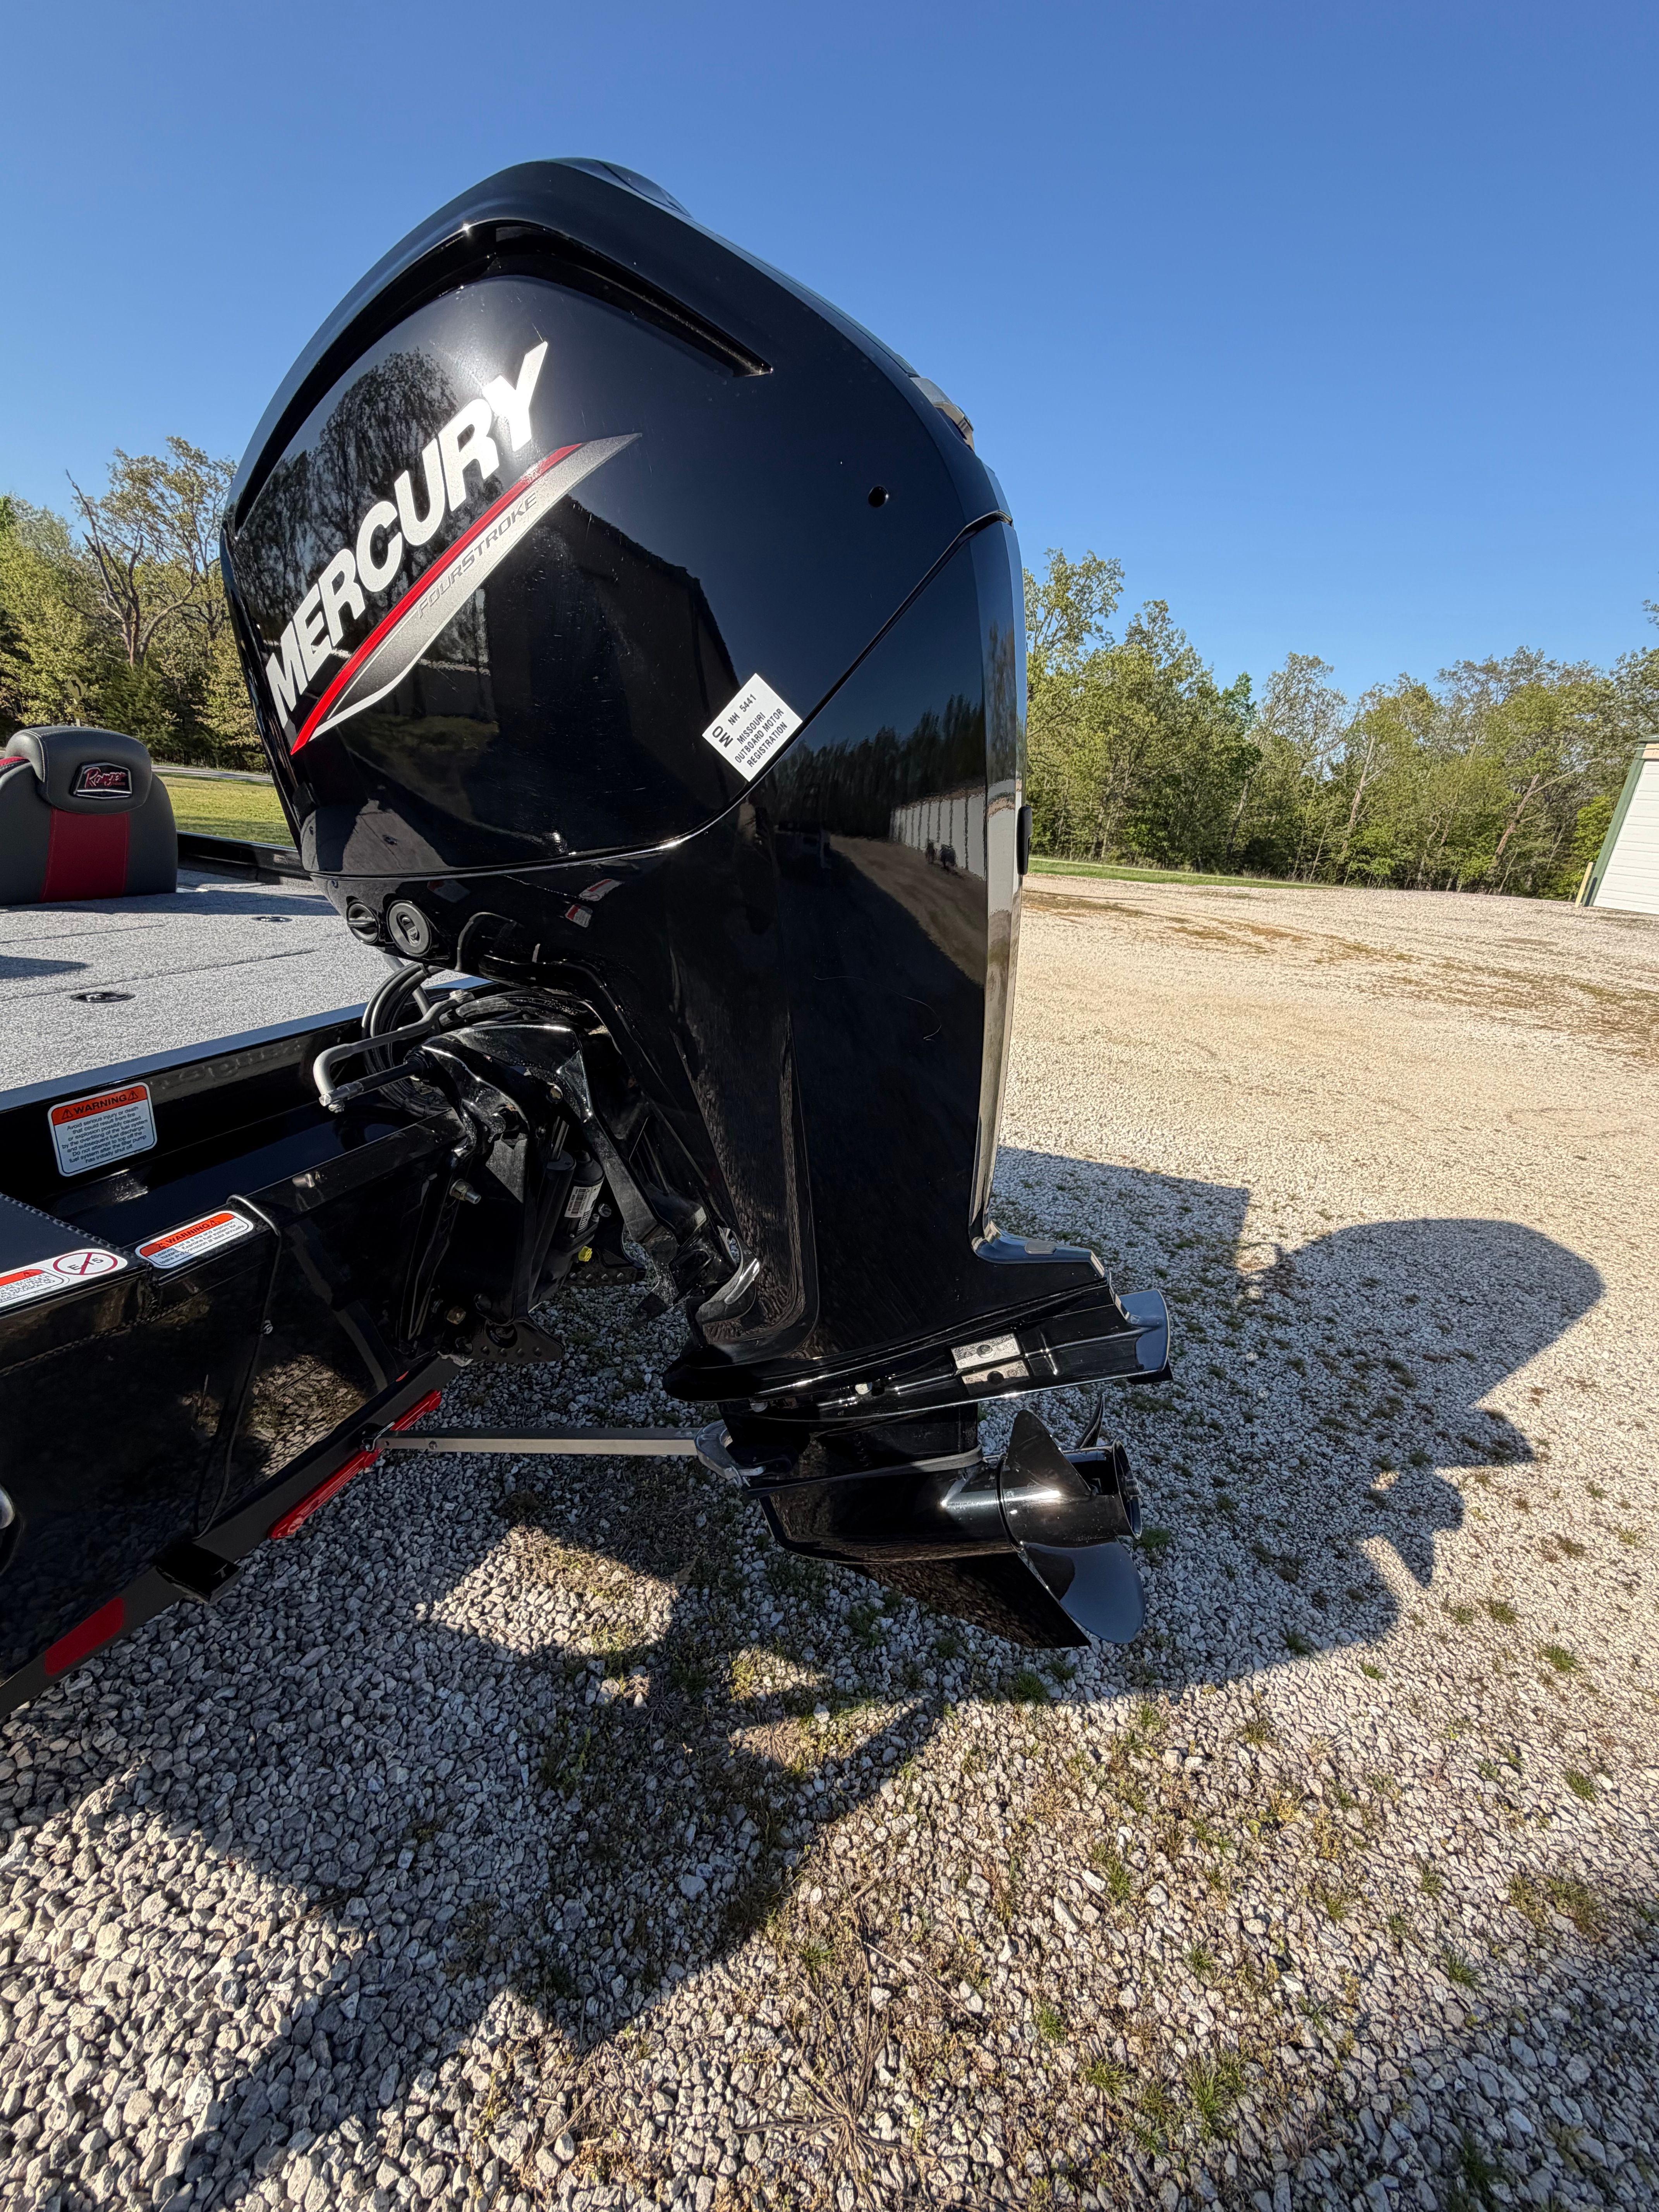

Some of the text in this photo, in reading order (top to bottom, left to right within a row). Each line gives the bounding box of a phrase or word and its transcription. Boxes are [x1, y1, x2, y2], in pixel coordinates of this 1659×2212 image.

[266, 341, 548, 728] MERCURY
[416, 491, 537, 619] FOURSTROKE
[728, 694, 756, 726] NH 5441
[735, 708, 784, 763] OUTBOARD MOTOR
[736, 711, 766, 745] MISSOURI
[747, 721, 788, 768] REGISTRATION
[83, 767, 126, 789] Ranger
[73, 1094, 127, 1115] WARNING
[67, 1123, 82, 1131] Avoid
[84, 1117, 102, 1126] serious
[75, 1128, 100, 1139] explosion
[101, 1122, 122, 1133] possibly
[123, 1115, 141, 1124] caused
[84, 1123, 99, 1131] could
[131, 1119, 148, 1127] system
[79, 1136, 108, 1149] subsequent
[81, 1150, 99, 1159] system
[132, 1135, 146, 1143] pump
[97, 1151, 113, 1160] initially
[165, 1223, 210, 1243] WARNING
